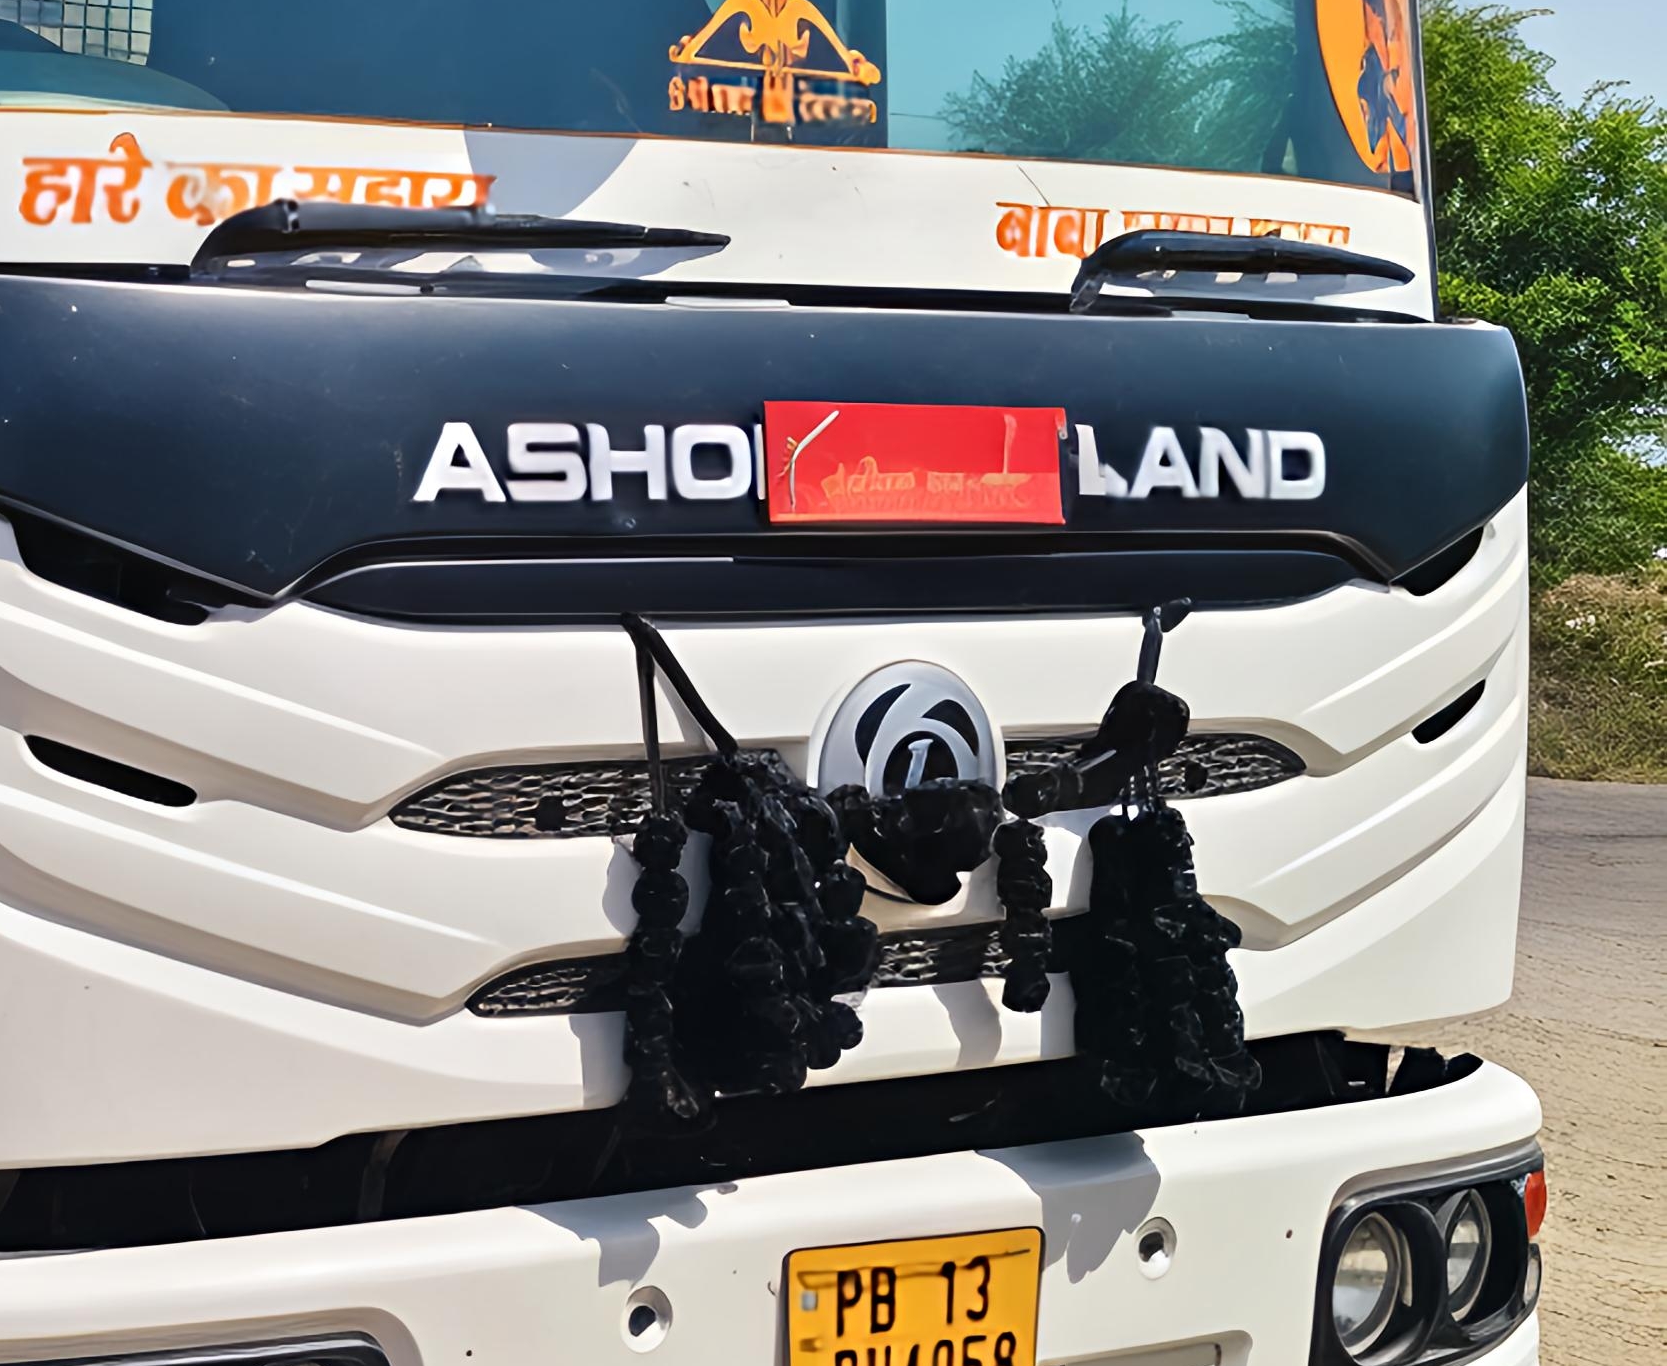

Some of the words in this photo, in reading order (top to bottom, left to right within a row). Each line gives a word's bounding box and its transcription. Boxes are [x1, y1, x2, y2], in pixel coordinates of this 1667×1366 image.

[19, 131, 153, 227] हारे
[412, 421, 766, 502] ASHO
[1074, 423, 1327, 501] LAND
[835, 1266, 897, 1338] PB
[939, 1254, 992, 1326] 13
